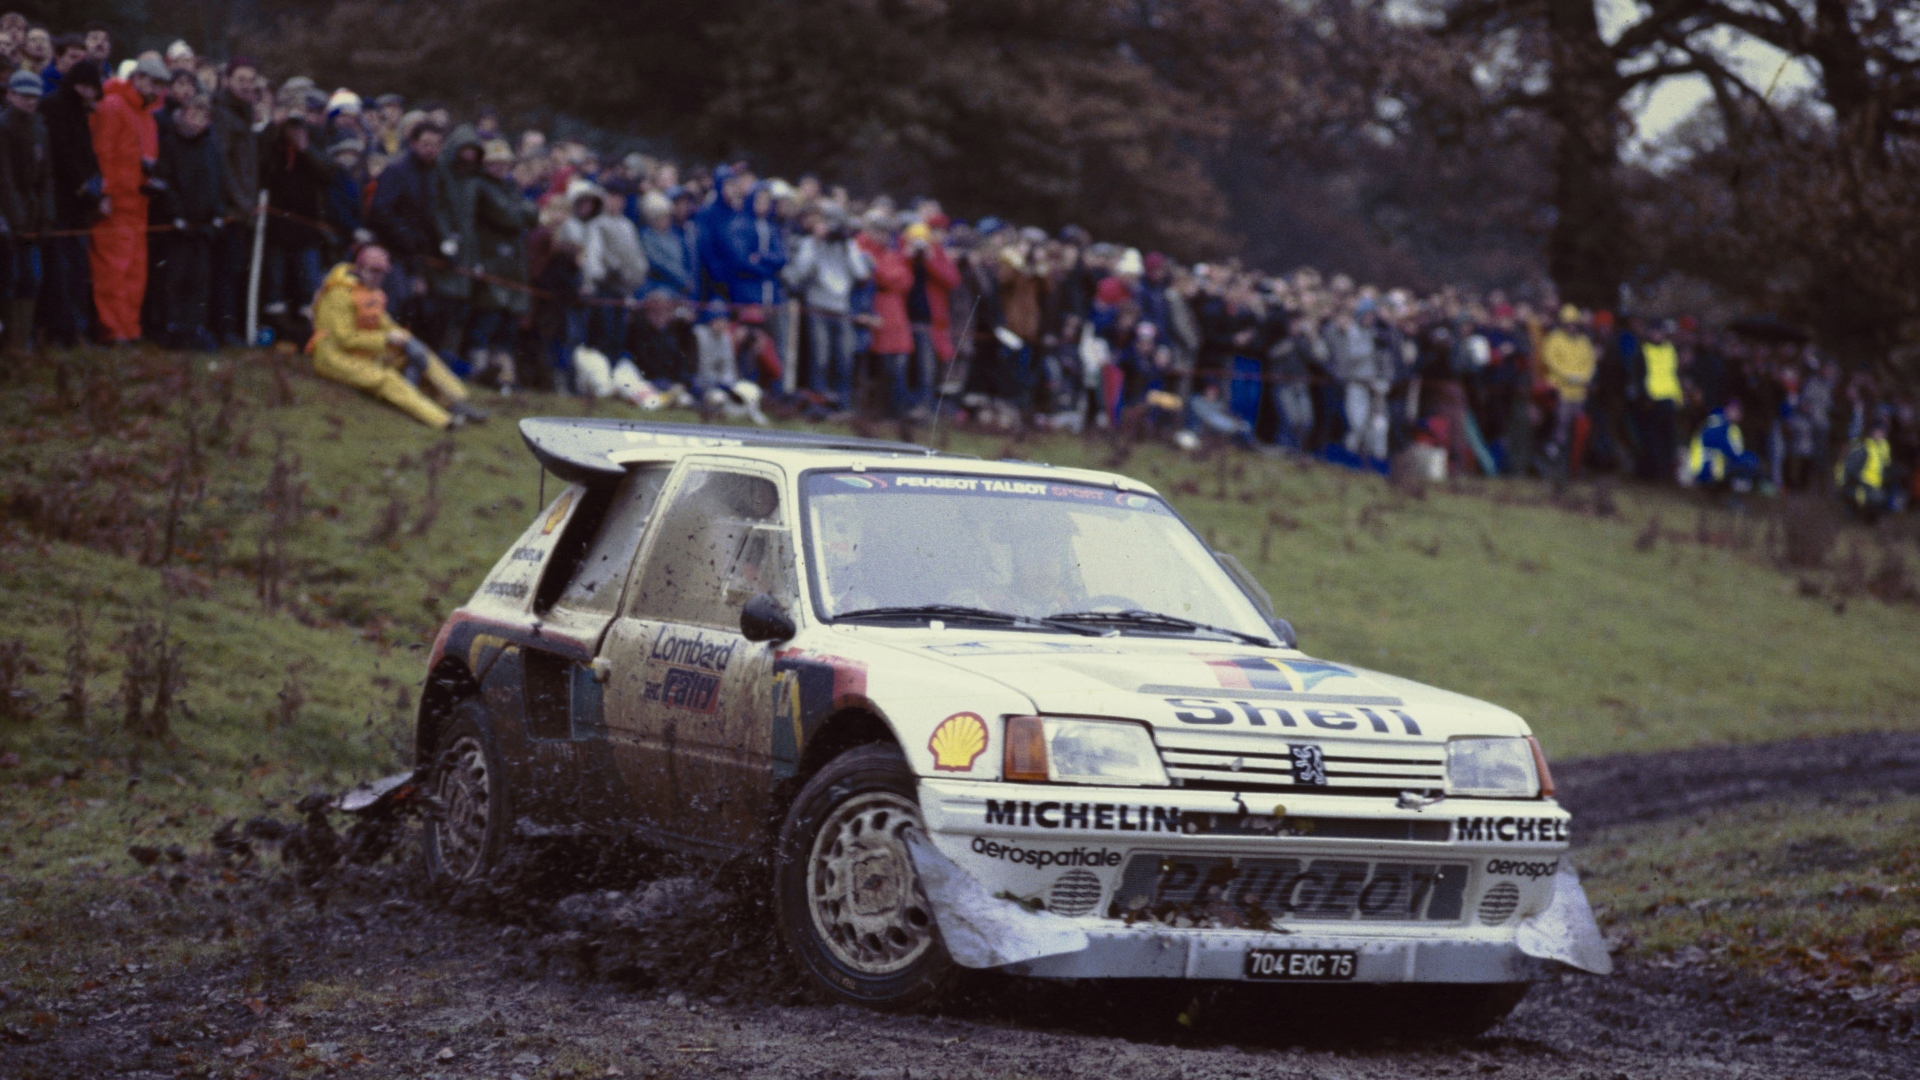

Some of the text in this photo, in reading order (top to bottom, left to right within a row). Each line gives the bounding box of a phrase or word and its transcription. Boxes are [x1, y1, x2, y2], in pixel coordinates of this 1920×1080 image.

[896, 476, 1104, 500] PEUGEOT TALBOT SPORT
[651, 625, 738, 671] Lombard
[1165, 698, 1422, 736] Shell
[985, 799, 1182, 832] MICHELIN
[1457, 816, 1570, 841] MICHEL
[972, 836, 1121, 869] aerospatiale
[1250, 953, 1353, 976] 704 EXC 75
